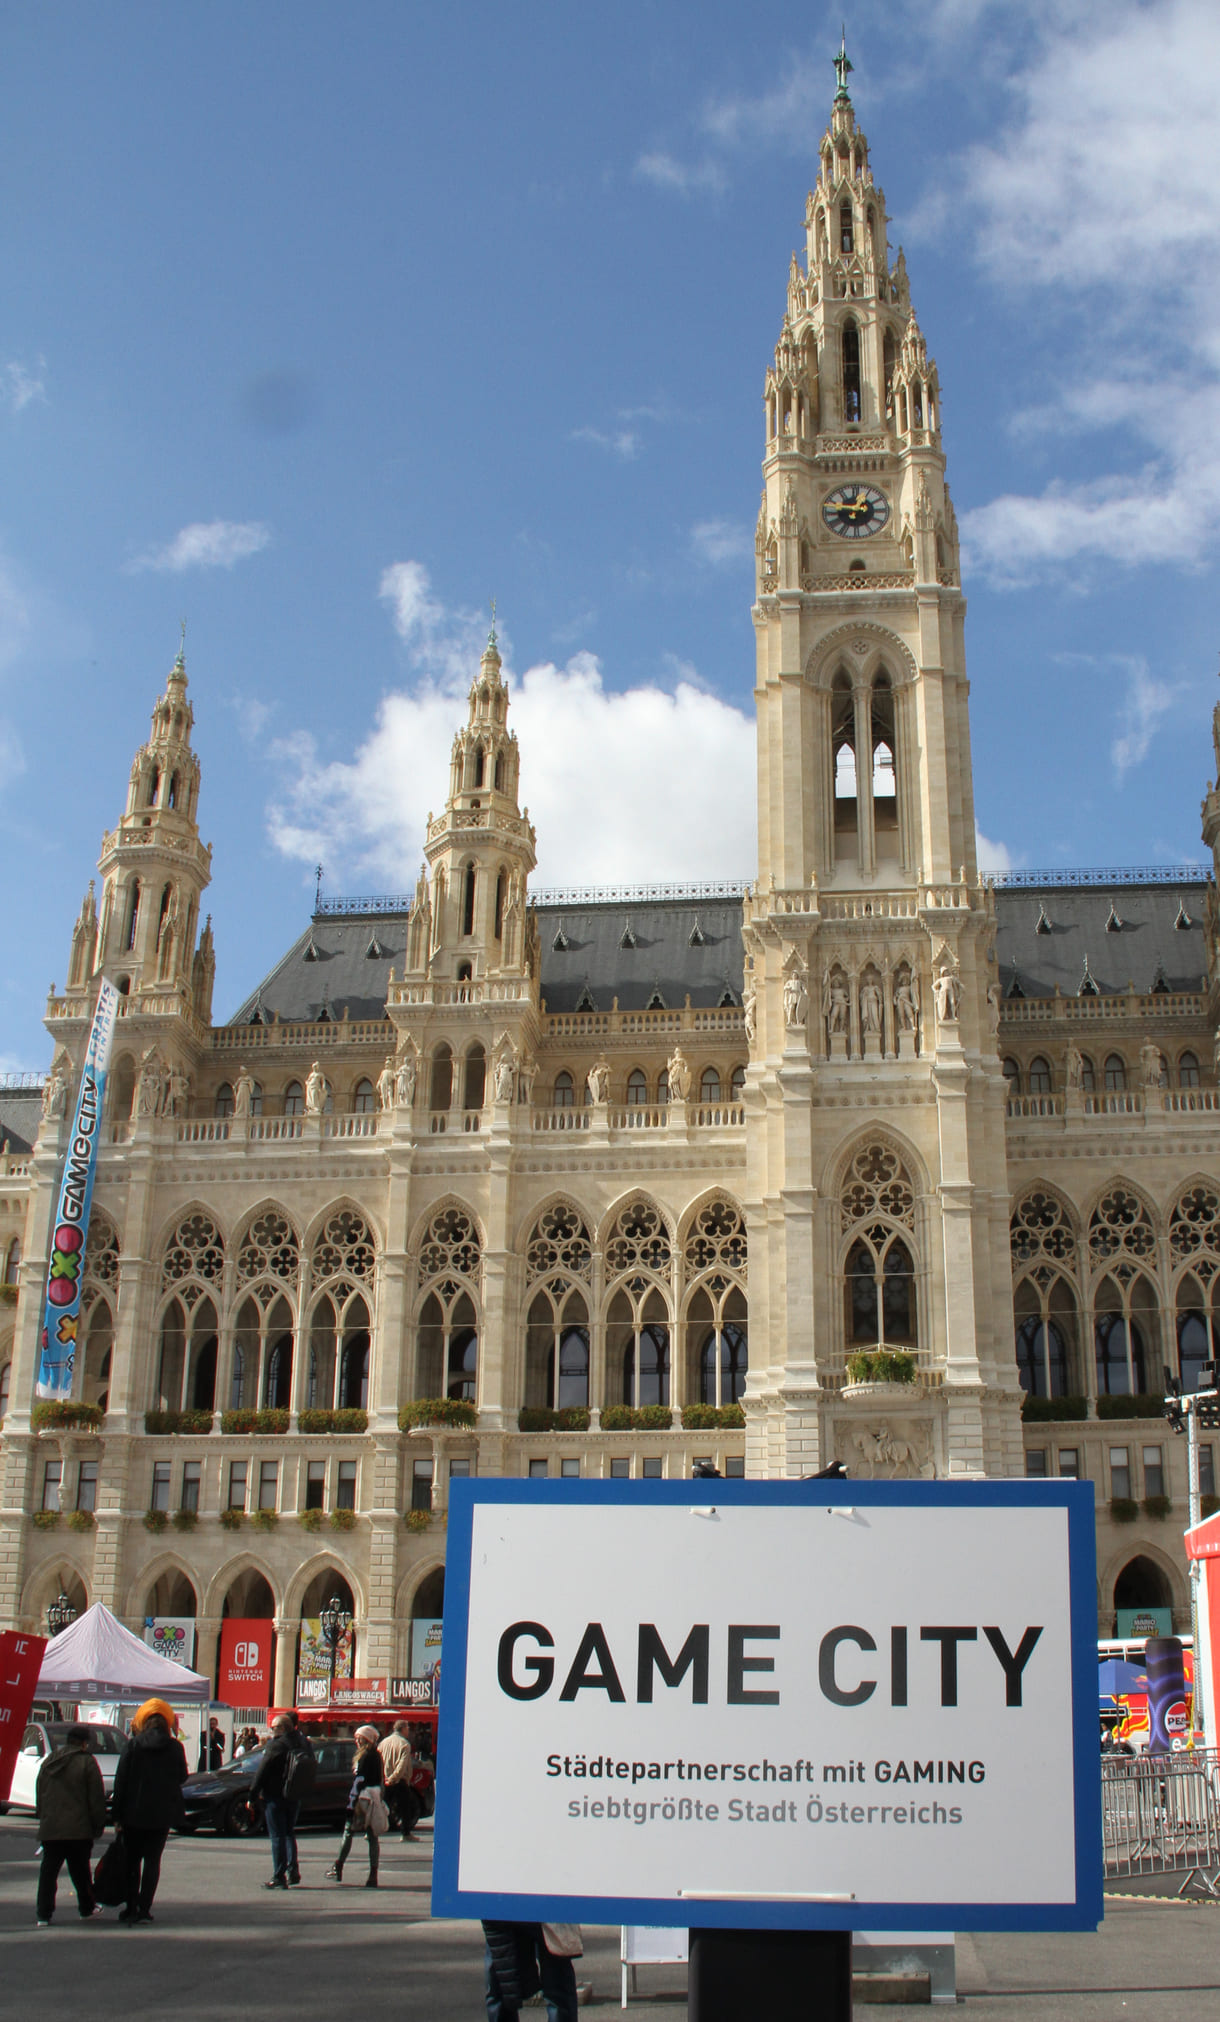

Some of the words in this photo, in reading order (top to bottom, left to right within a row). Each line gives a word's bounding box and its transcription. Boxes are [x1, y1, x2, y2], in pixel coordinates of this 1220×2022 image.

[89, 984, 111, 1055] GRATIS
[497, 1621, 780, 1705] GAME
[818, 1625, 1044, 1707] CITY
[51, 1682, 132, 1695] TESLA
[299, 1679, 328, 1697] LANGOS
[393, 1680, 431, 1698] LANGOS
[546, 1754, 814, 1784] Städtepartnerschaft
[823, 1760, 866, 1783] mit
[874, 1760, 986, 1784] GAMING
[568, 1795, 719, 1825] siebtgrößte
[727, 1799, 798, 1822] Stadt
[806, 1794, 963, 1824] Österreichs
